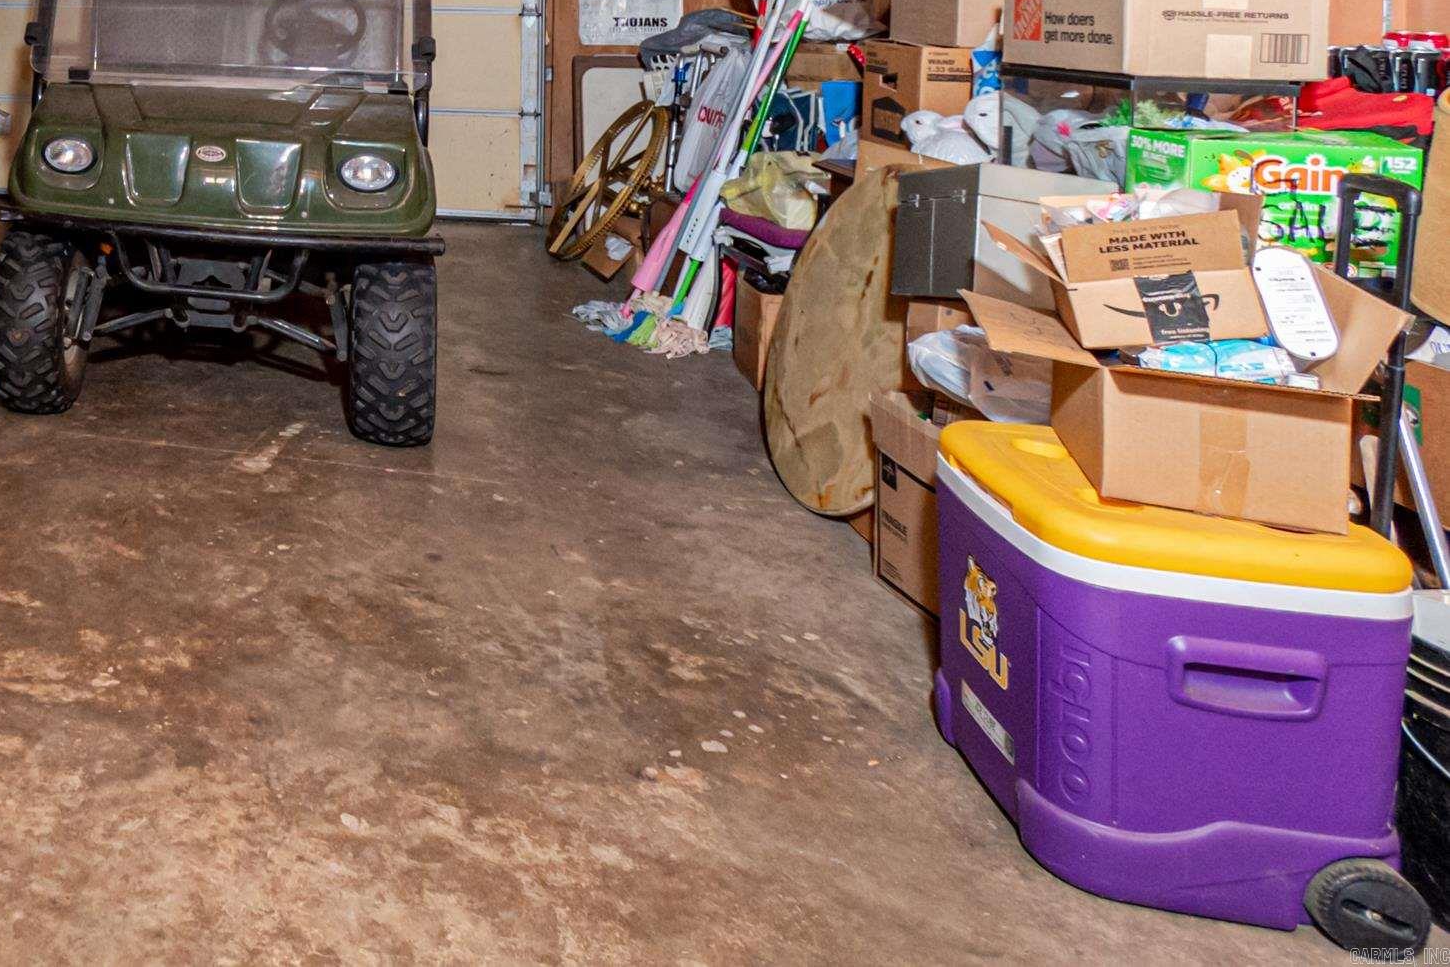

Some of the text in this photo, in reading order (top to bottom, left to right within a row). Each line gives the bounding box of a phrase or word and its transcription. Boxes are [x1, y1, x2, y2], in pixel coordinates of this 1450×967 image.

[1044, 11, 1095, 26] How doers
[1244, 11, 1289, 20] RETURNS
[1044, 30, 1058, 44] get
[1060, 31, 1084, 44] more
[1153, 138, 1186, 159] MORE
[1385, 157, 1418, 170] 152
[1251, 156, 1346, 193] Gain
[1108, 230, 1186, 245] MADE WITH
[1099, 237, 1200, 254] LESS MATERIAL
[959, 608, 1009, 691] LSU
